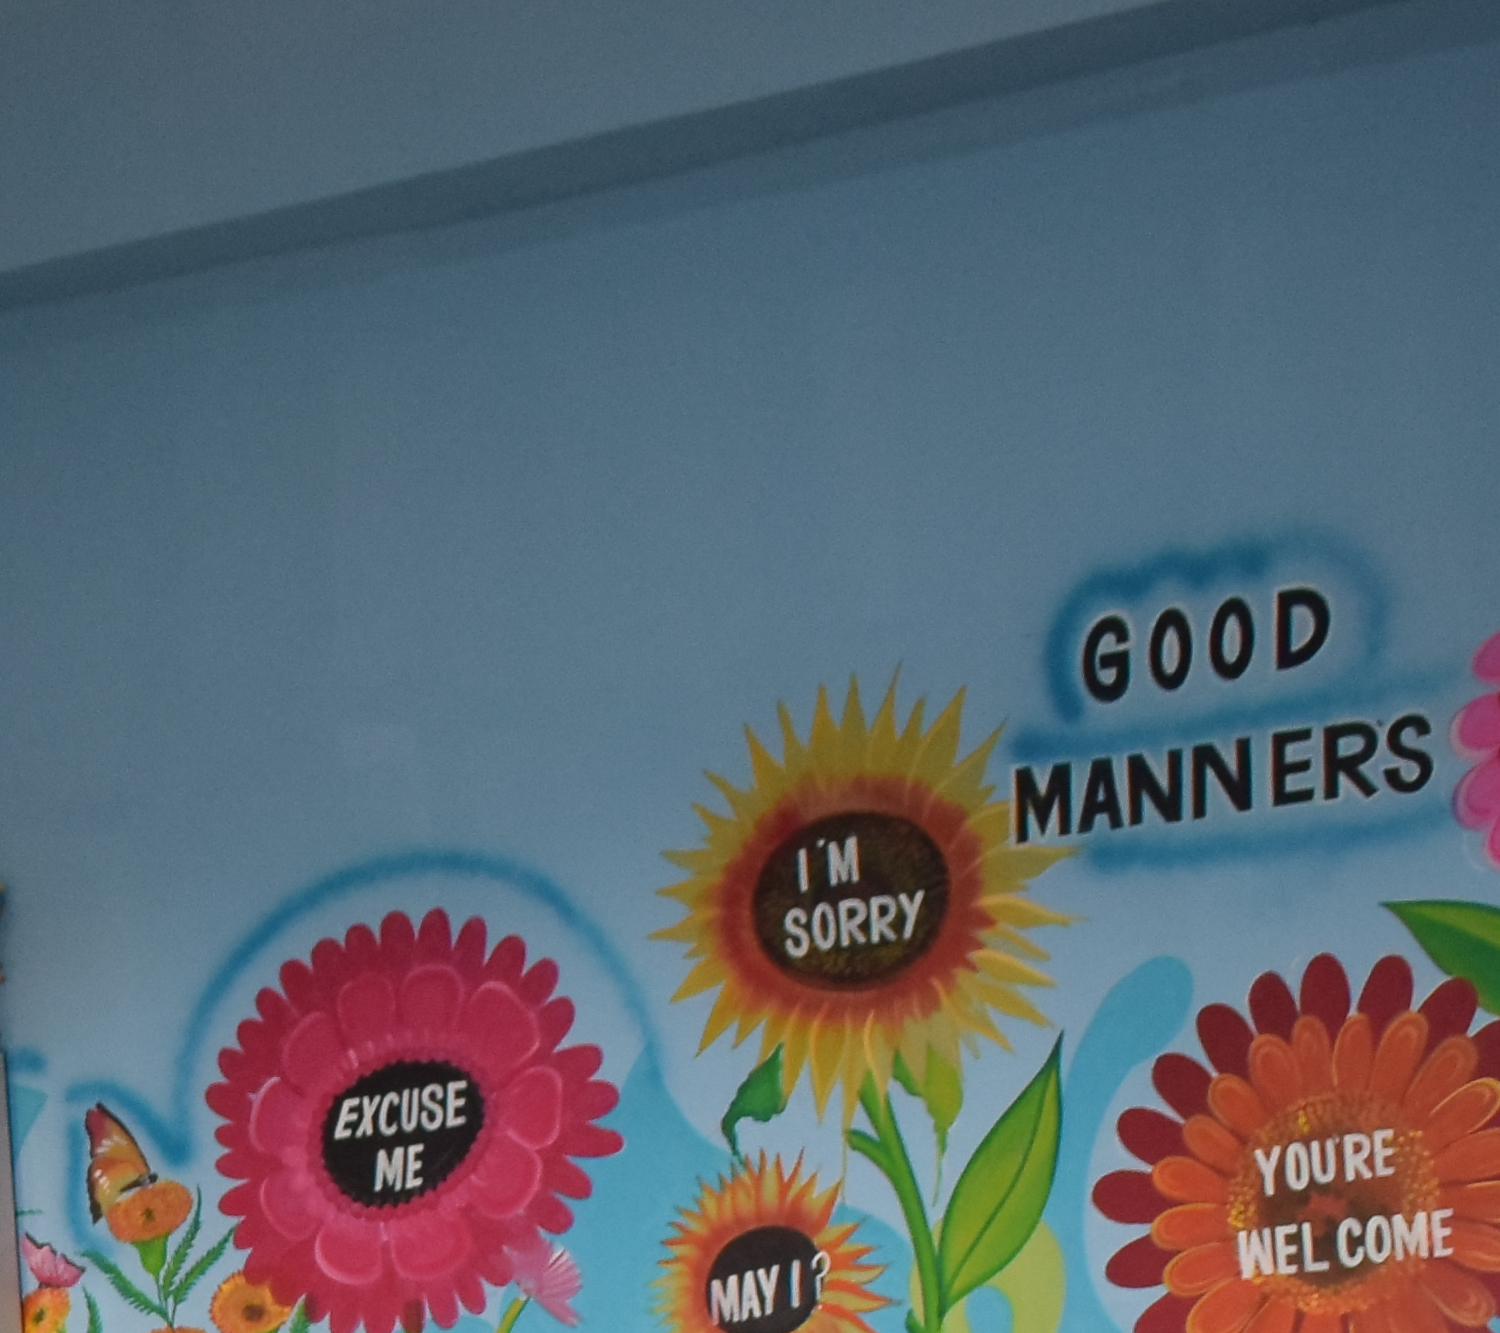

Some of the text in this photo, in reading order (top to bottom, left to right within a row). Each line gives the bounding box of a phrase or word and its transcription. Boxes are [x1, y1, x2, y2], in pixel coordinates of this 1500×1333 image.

[1082, 587, 1331, 703] GOOD
[1014, 713, 1435, 845] MANNERS
[783, 888, 925, 959] SORRY
[333, 1079, 468, 1140] EXCUSE
[373, 1143, 425, 1193] ME
[710, 1264, 780, 1326] MAY
